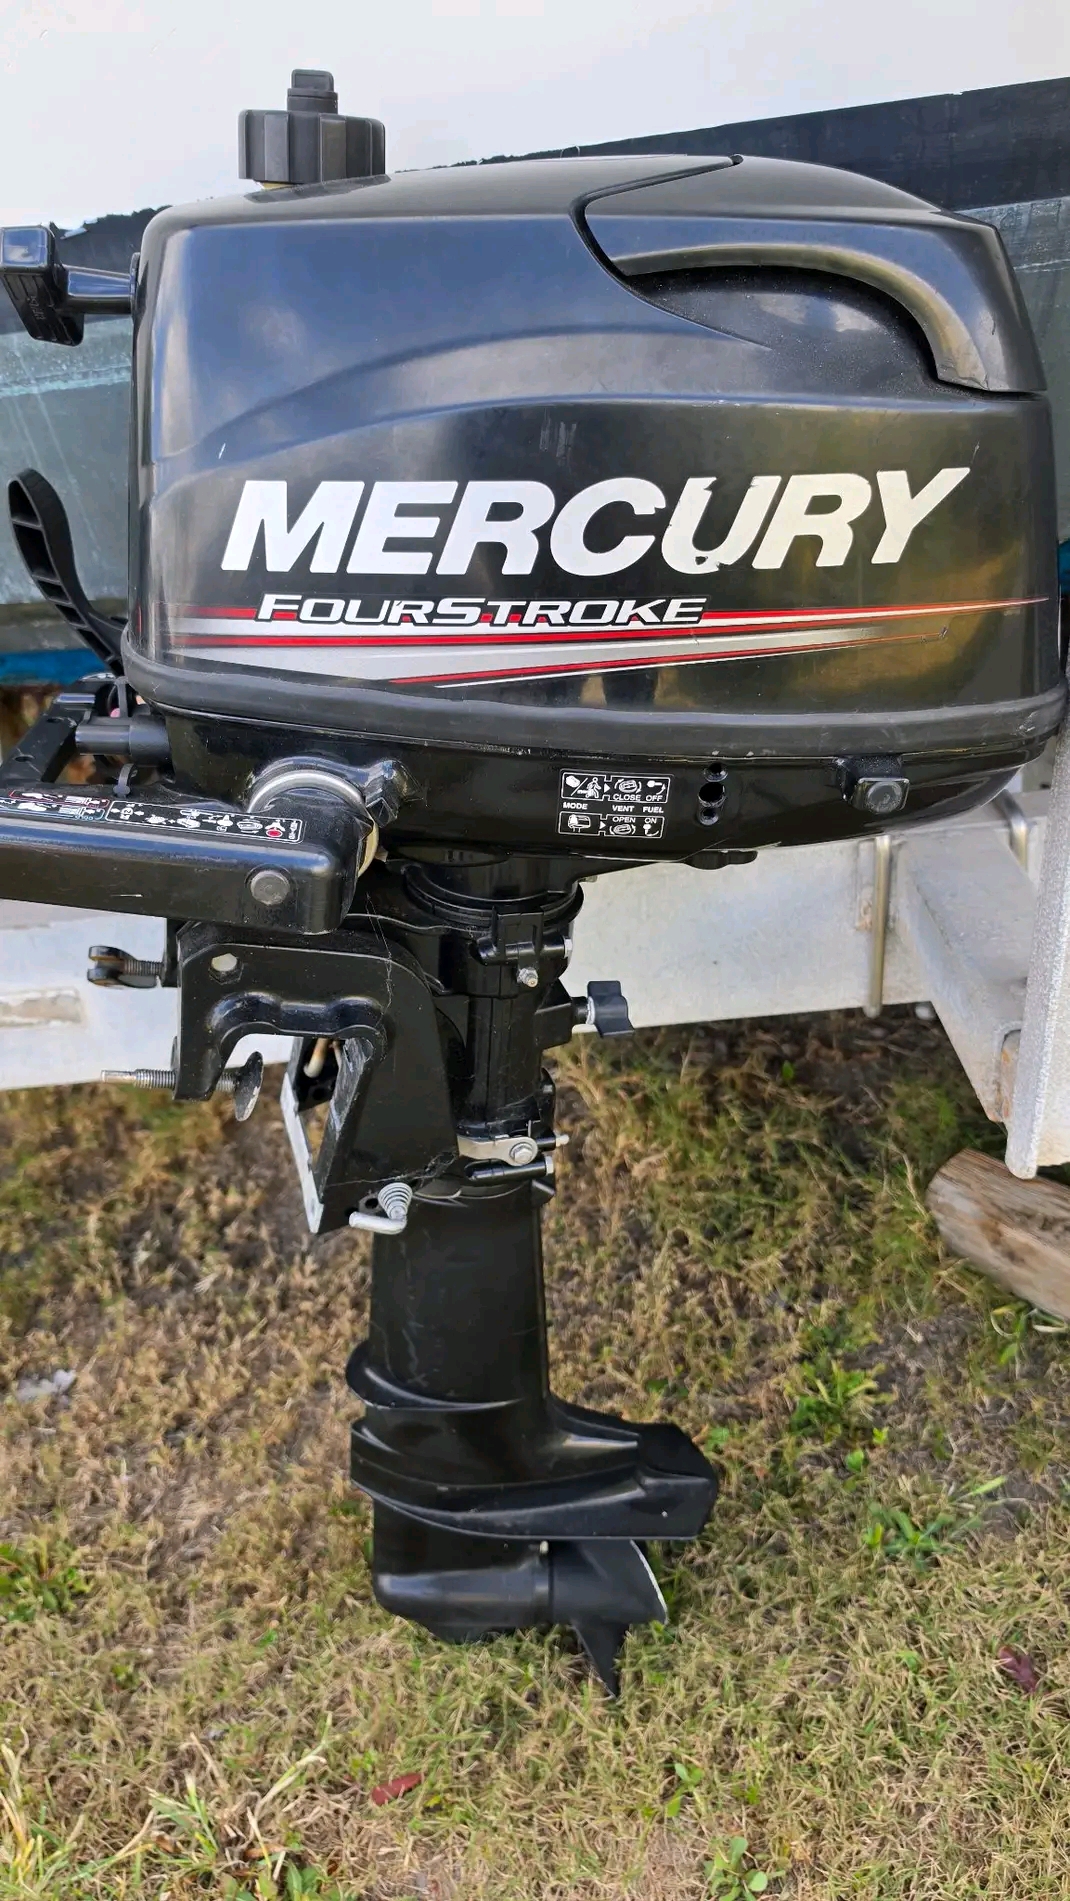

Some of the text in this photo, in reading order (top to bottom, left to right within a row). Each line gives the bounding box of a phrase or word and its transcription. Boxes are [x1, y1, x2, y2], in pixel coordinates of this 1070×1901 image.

[221, 467, 970, 576] MERCURY
[256, 594, 706, 627] FOURSTROKE
[562, 802, 588, 810] MODE
[612, 804, 635, 812] VENT
